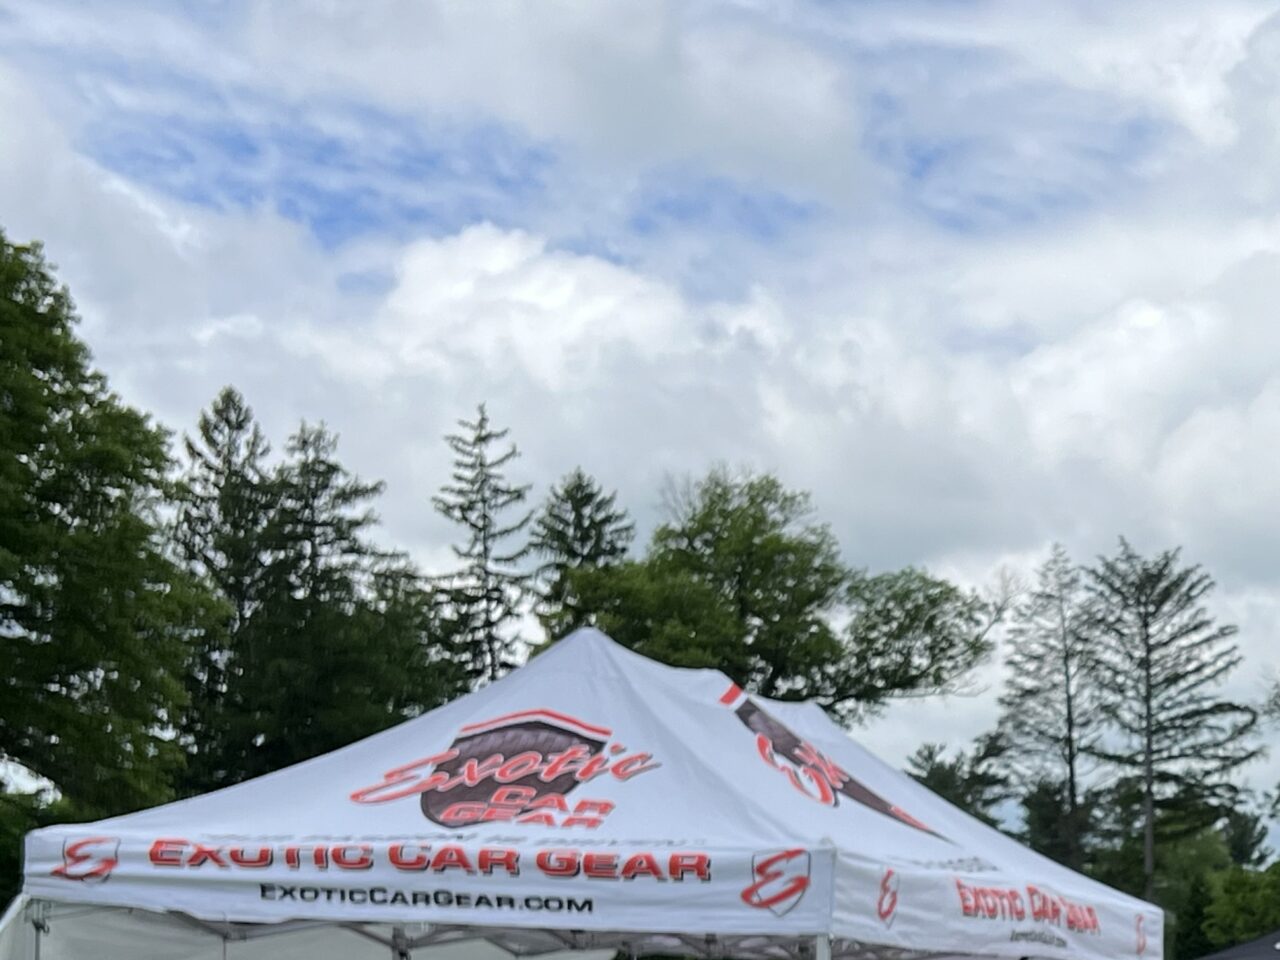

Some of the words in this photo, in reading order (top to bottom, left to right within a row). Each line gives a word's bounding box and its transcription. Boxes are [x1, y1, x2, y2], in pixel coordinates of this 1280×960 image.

[350, 744, 661, 804] Exotic
[440, 802, 604, 828] GEAR
[491, 785, 615, 815] CAR
[149, 838, 374, 869] EXOTIC
[388, 843, 520, 878] CAR
[535, 849, 711, 882] GEAR
